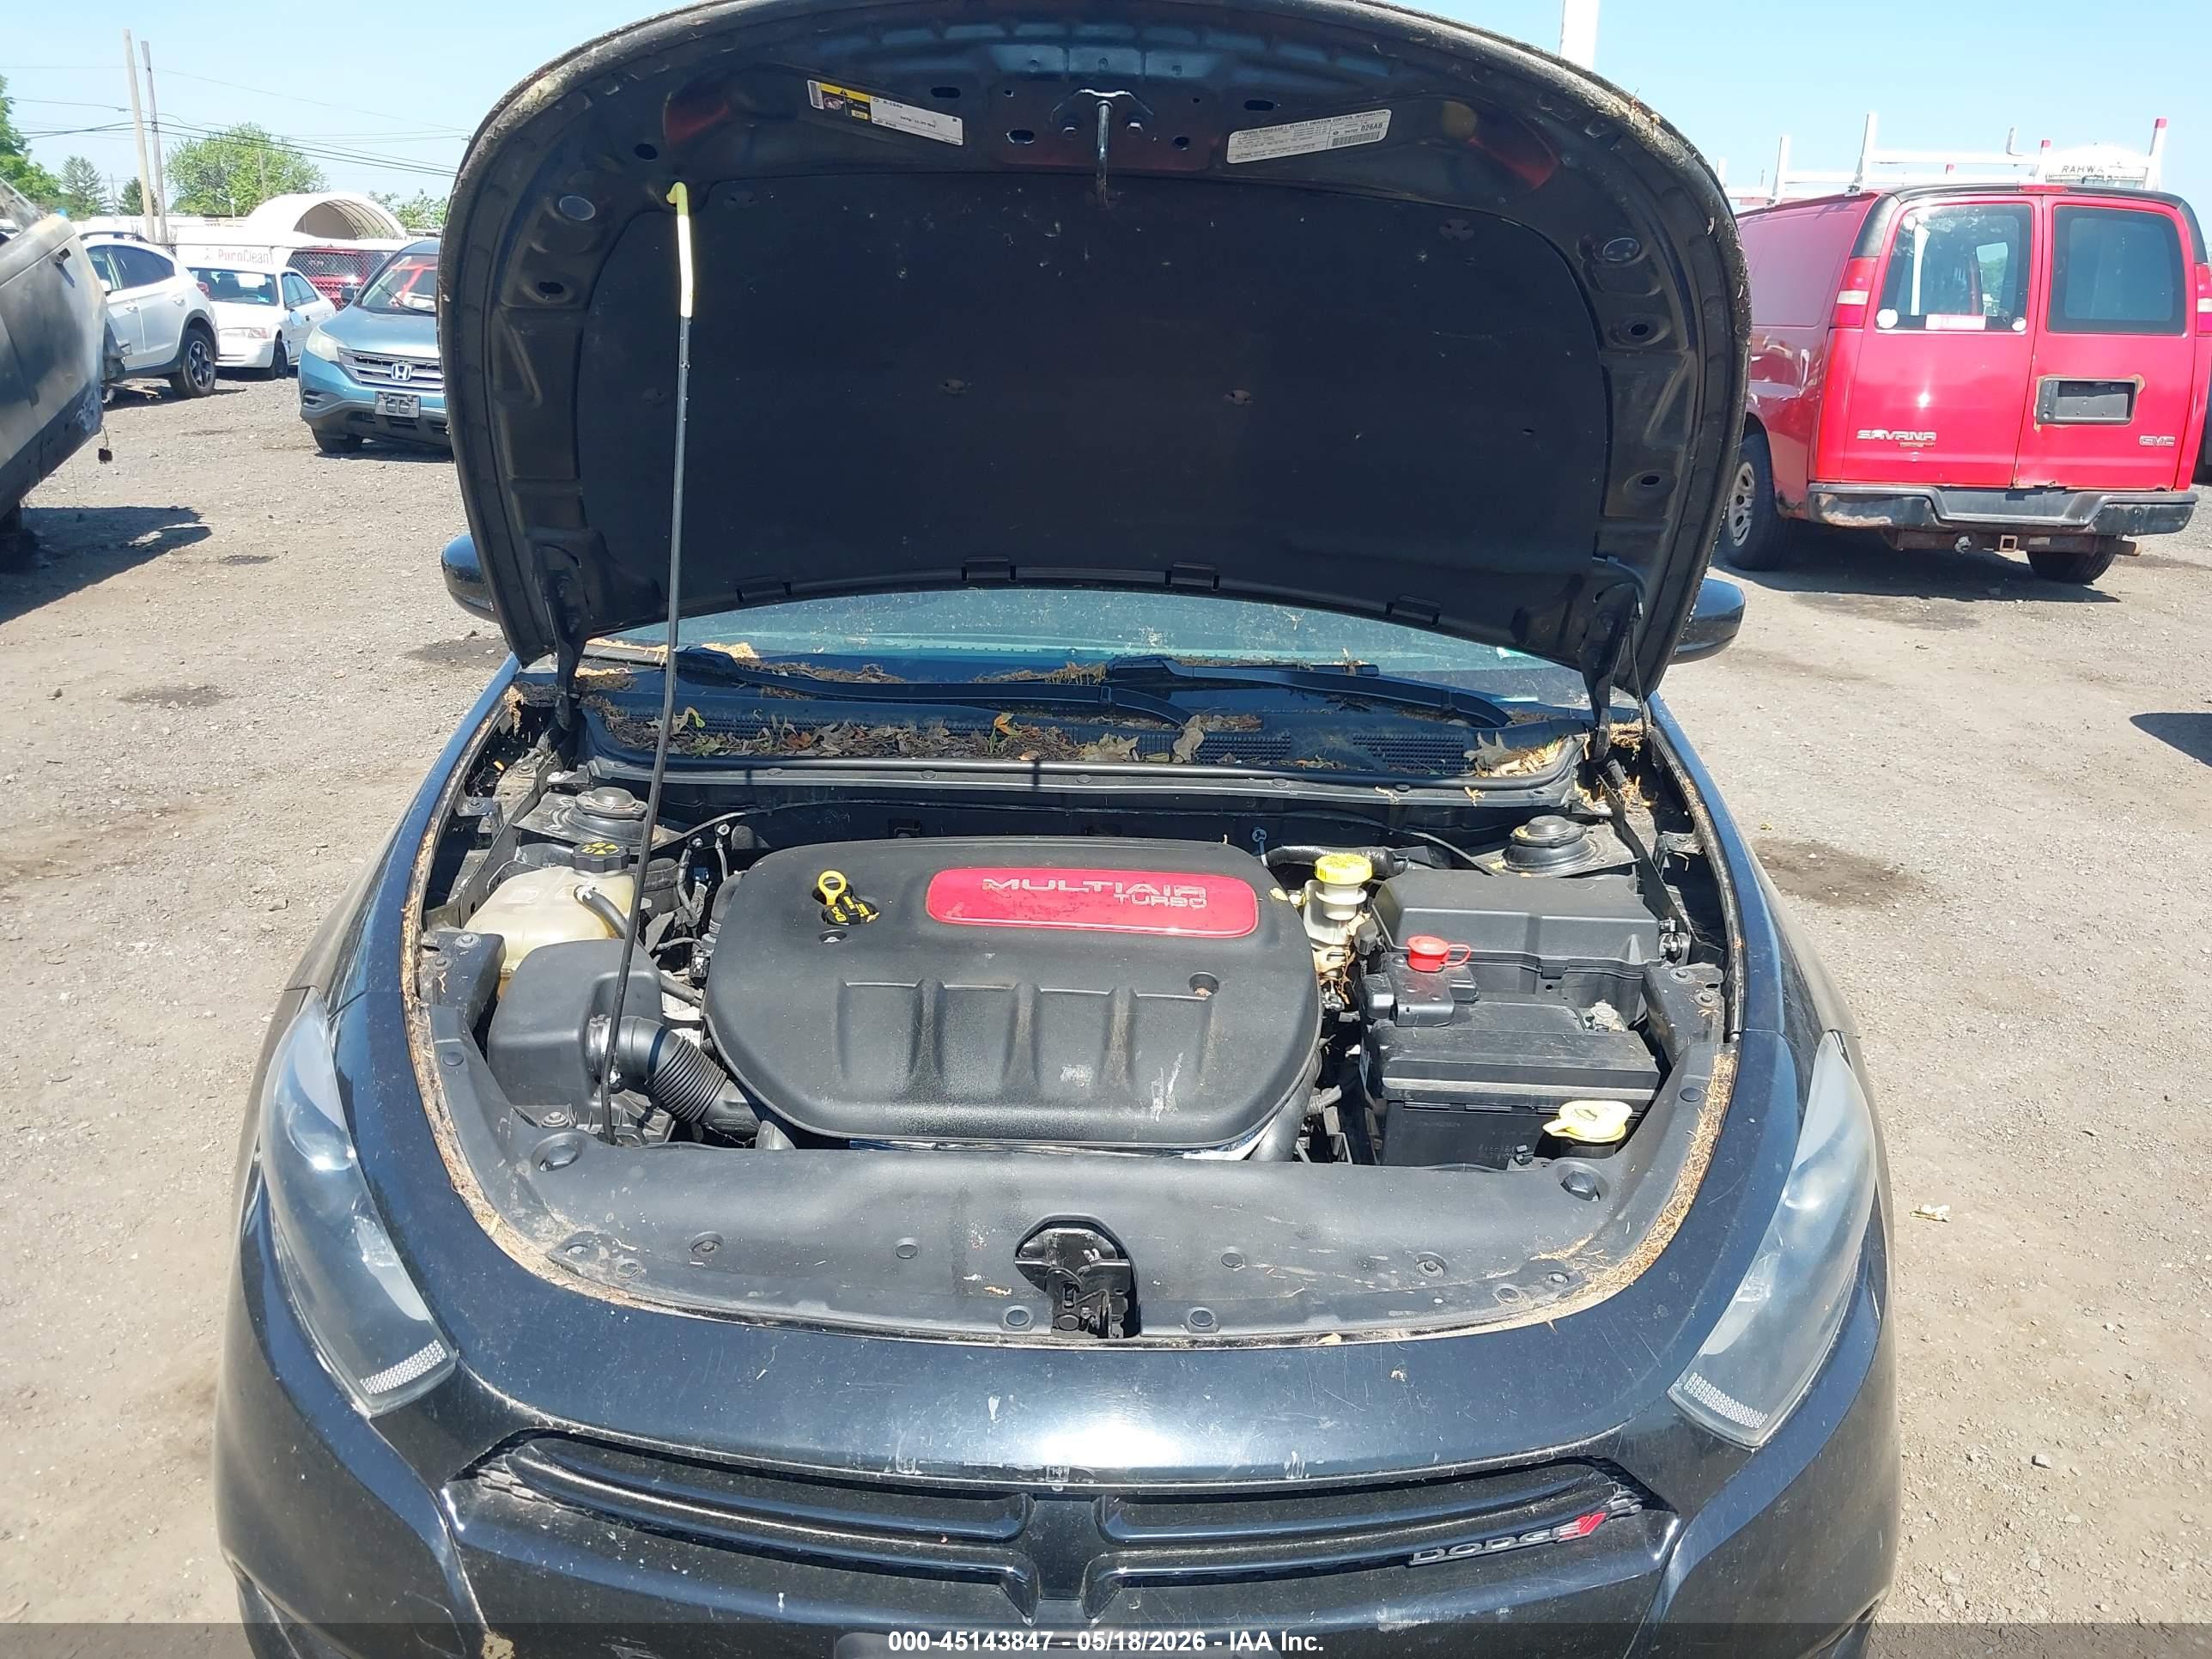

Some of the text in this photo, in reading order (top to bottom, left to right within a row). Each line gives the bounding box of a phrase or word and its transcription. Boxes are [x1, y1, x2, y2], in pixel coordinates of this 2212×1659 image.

[1856, 428, 1937, 441] SAVANA
[2139, 434, 2176, 447] GMC
[981, 878, 1206, 897] MULTIAIR
[1114, 893, 1207, 908] TURBO
[1410, 1522, 1582, 1564] DODGE
